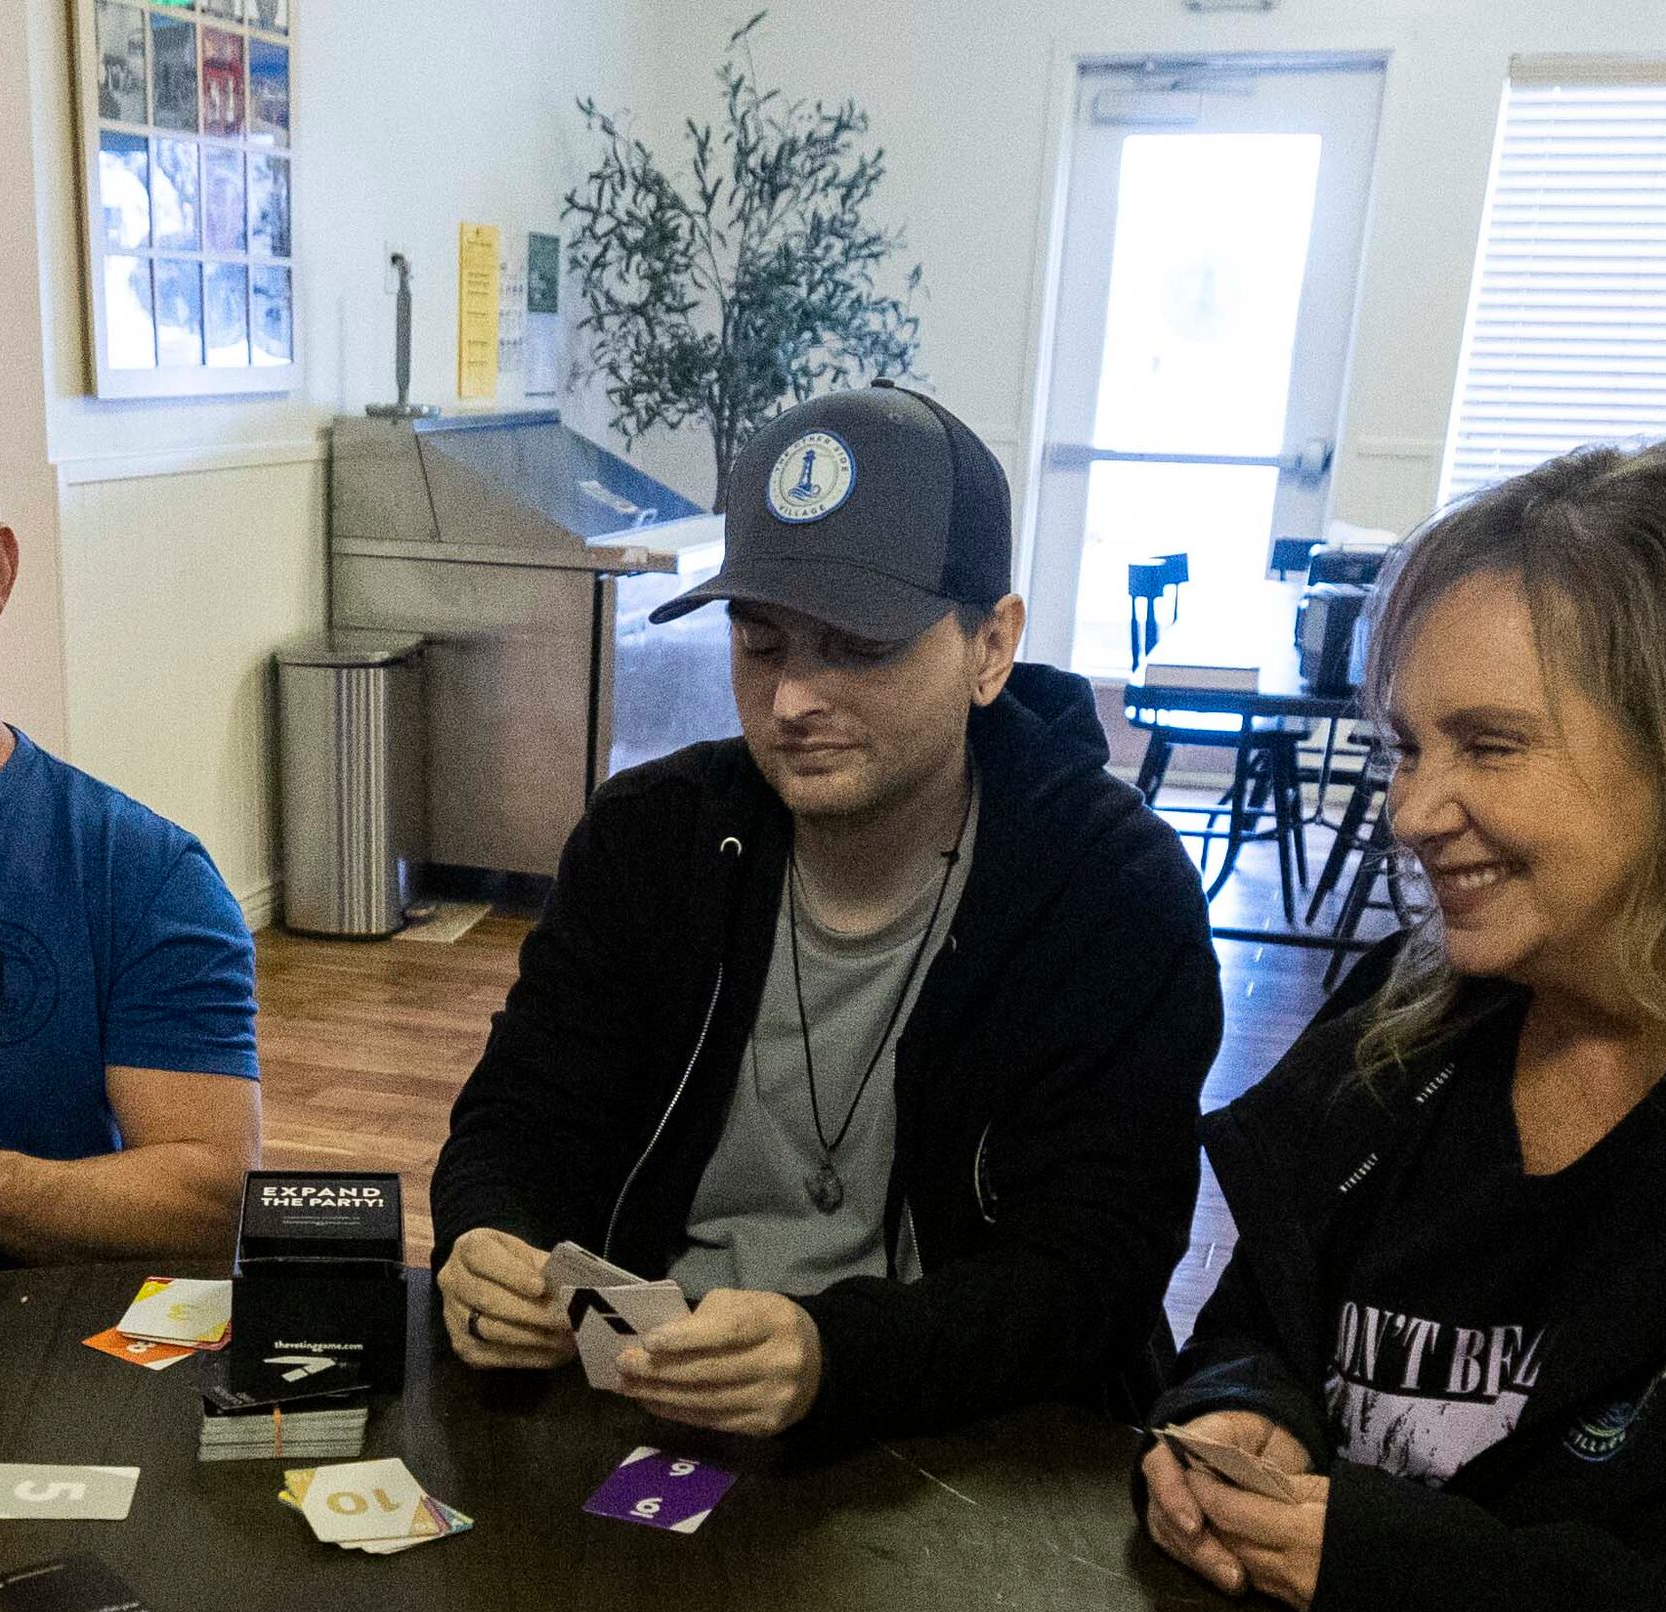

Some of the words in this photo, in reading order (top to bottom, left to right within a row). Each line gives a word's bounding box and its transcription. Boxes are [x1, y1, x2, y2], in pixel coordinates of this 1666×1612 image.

[793, 435, 831, 449] OTHER
[833, 446, 849, 472] SIDE
[779, 504, 826, 517] VILLAGE
[261, 1198, 303, 1207] THE
[309, 1198, 384, 1207] PARTY!
[263, 1186, 381, 1198] EXPAND
[1336, 1301, 1441, 1391] ON'T
[14, 1478, 86, 1502] 5
[326, 1488, 402, 1516] 10
